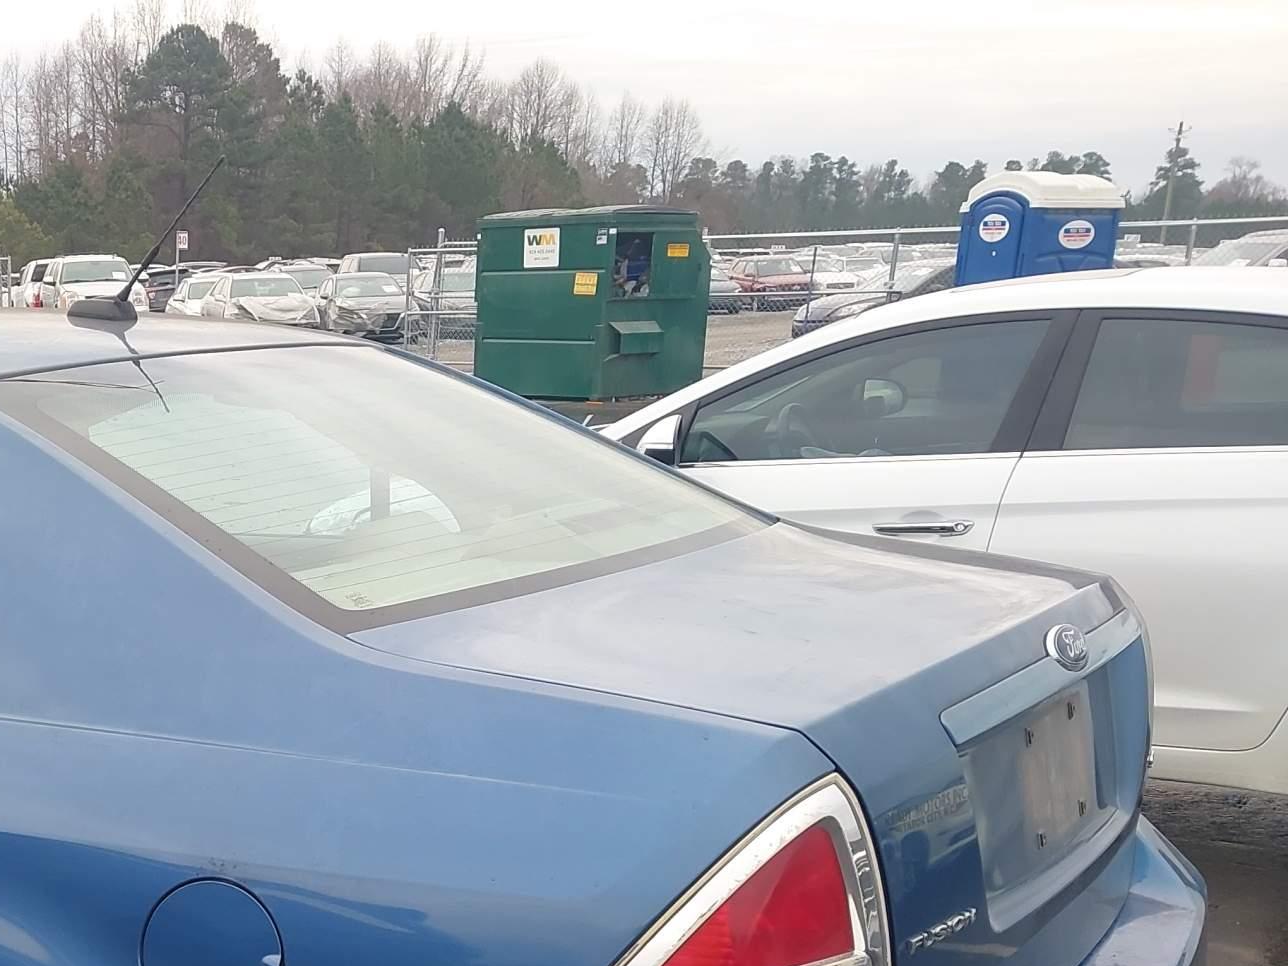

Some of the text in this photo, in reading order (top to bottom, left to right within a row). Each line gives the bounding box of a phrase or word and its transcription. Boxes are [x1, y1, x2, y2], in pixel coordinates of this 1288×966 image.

[527, 233, 556, 246] WM
[1062, 629, 1085, 657] Ford
[908, 907, 977, 955] FUSION
